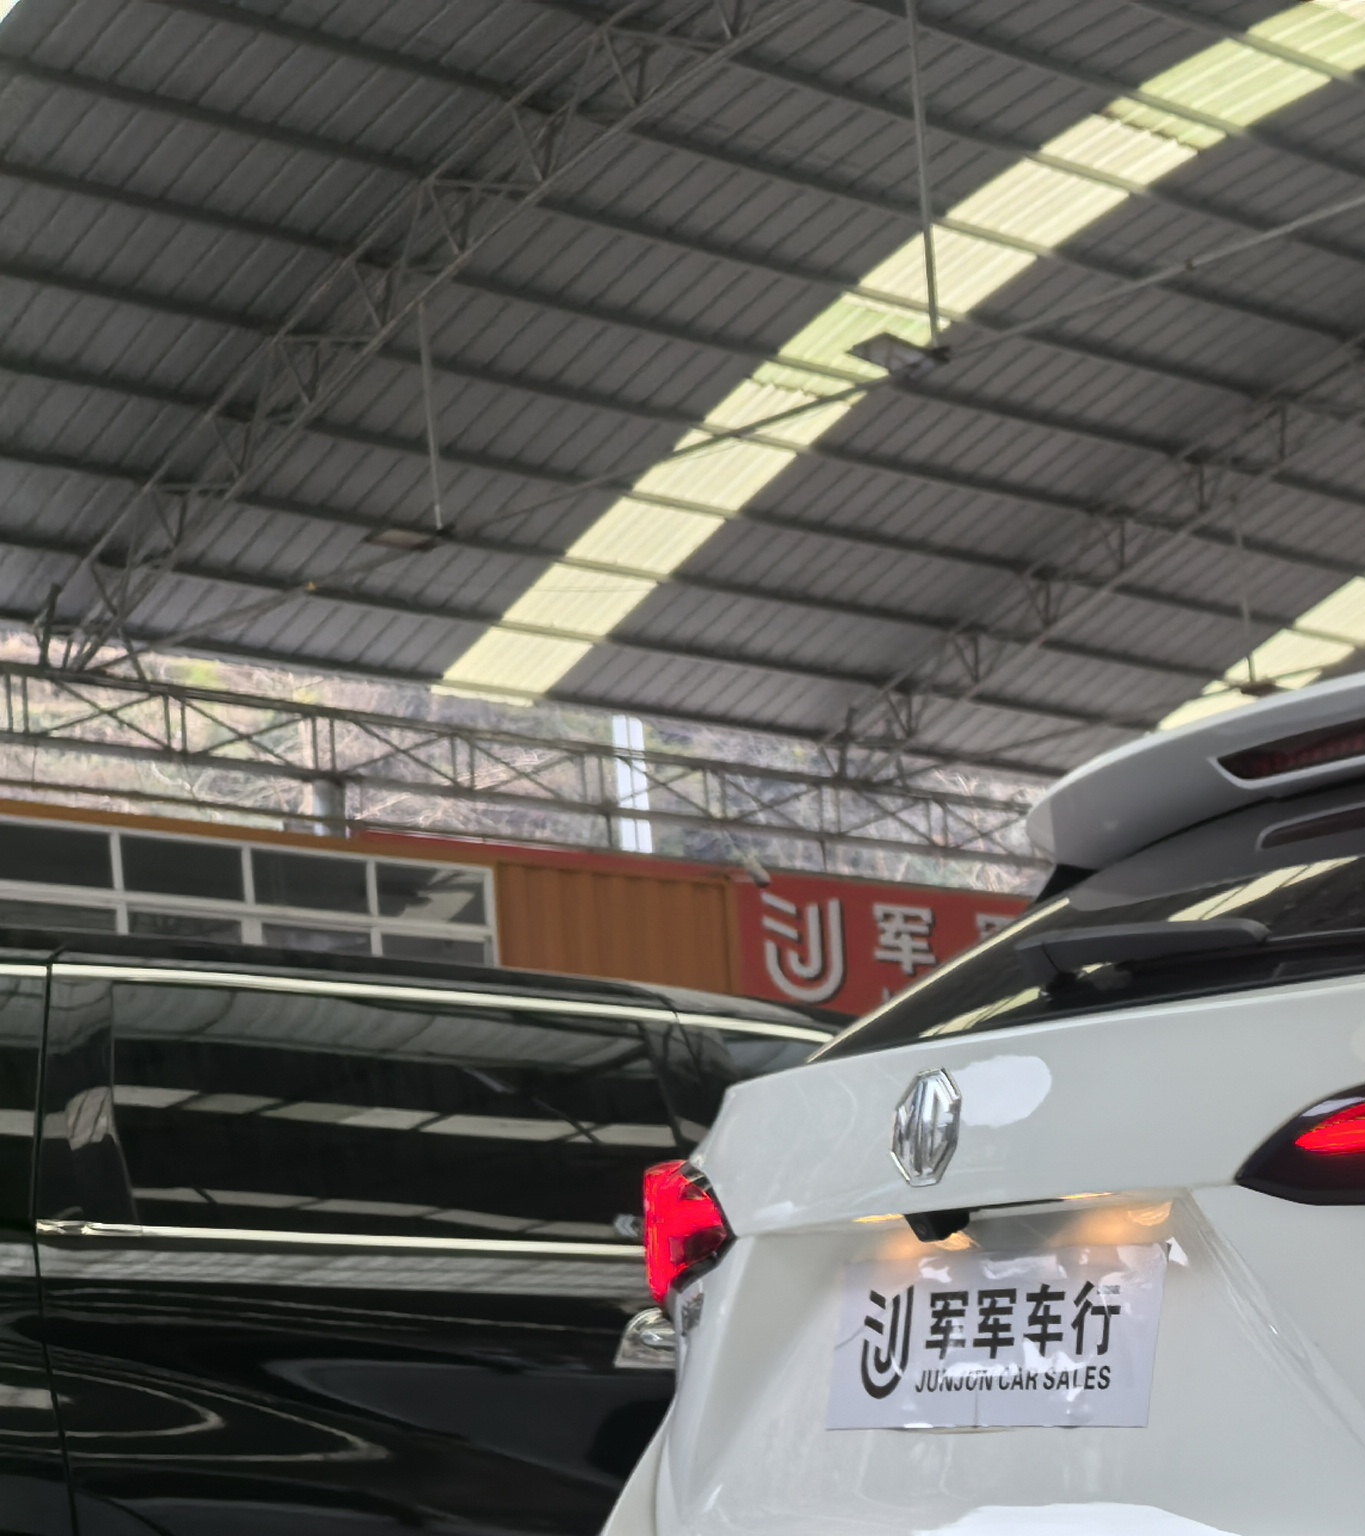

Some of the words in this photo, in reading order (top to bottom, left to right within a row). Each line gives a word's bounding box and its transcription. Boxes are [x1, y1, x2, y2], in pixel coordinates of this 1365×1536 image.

[925, 1280, 1121, 1360] 军军车行
[916, 1368, 994, 1393] JUNJUN
[999, 1368, 1038, 1392] CAR
[1043, 1366, 1111, 1391] SALES
